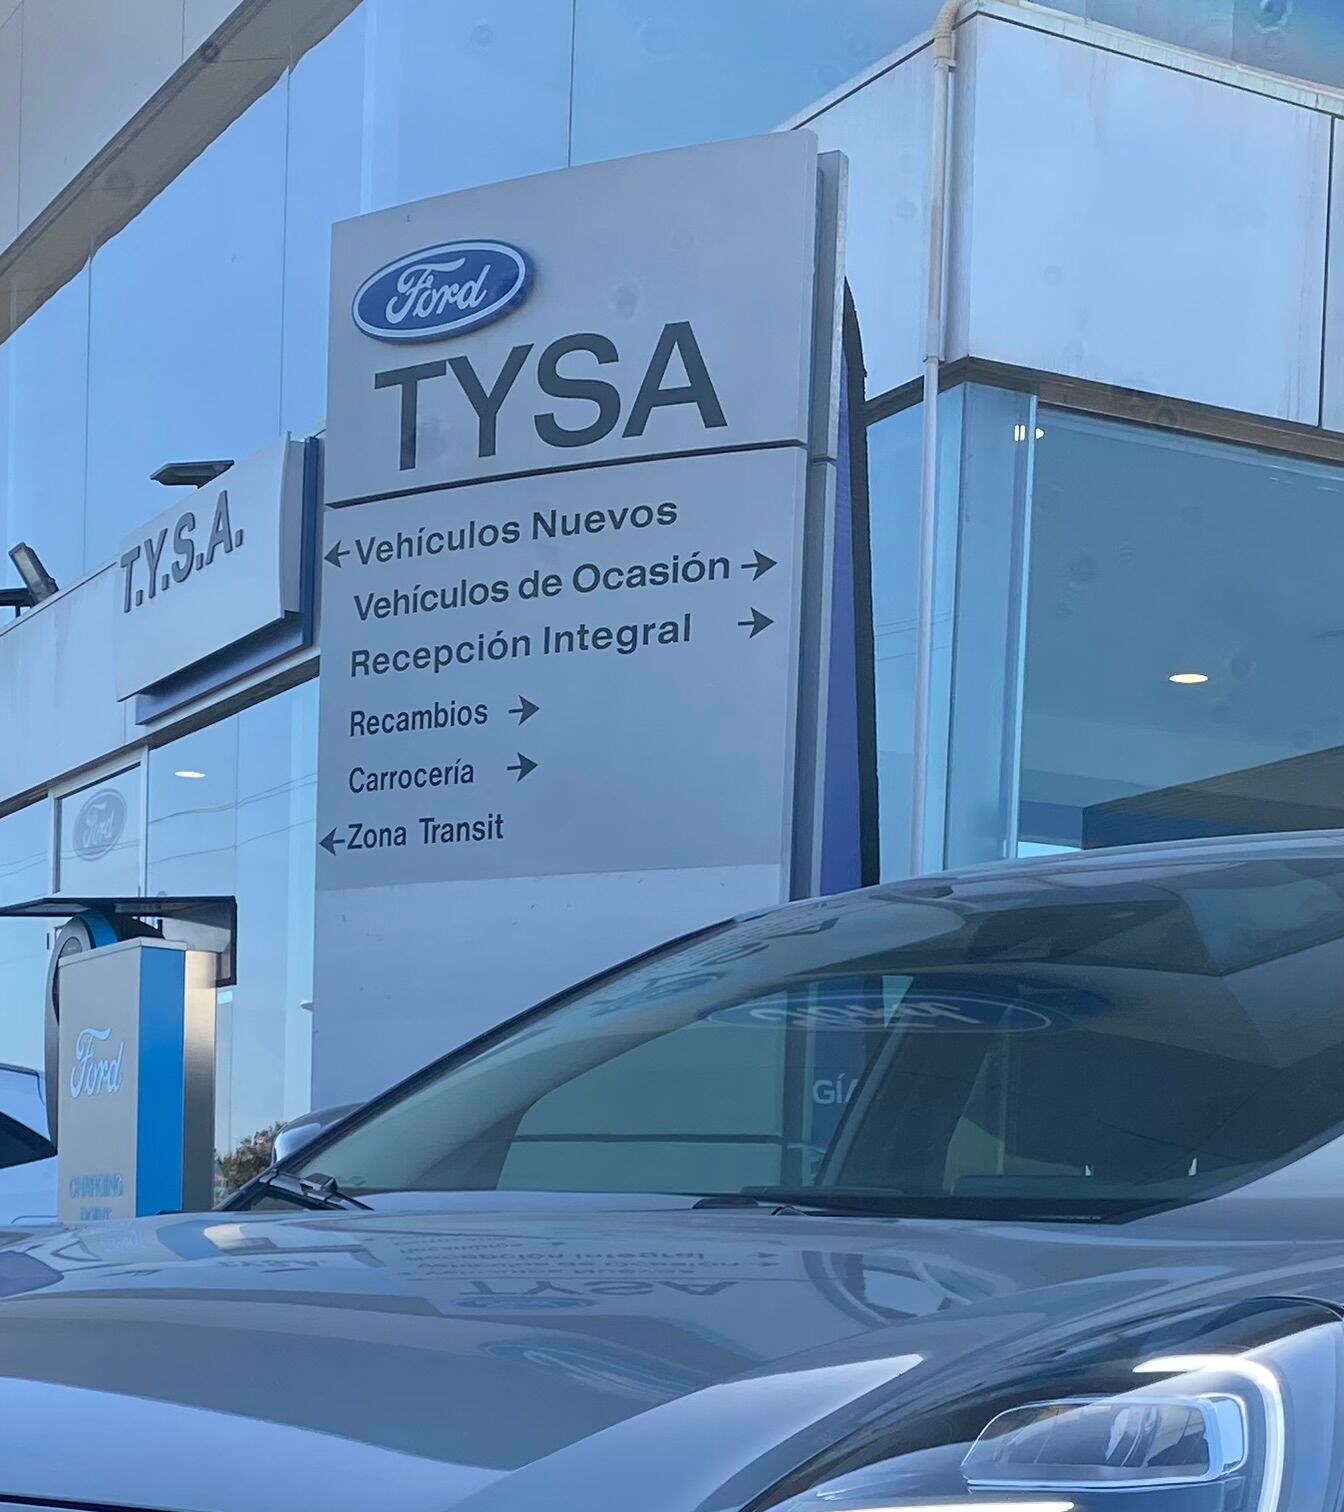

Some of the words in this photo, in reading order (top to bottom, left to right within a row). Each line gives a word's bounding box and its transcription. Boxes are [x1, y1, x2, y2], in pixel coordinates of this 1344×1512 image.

[385, 257, 491, 324] Ford
[374, 321, 728, 471] TYSA
[120, 490, 244, 613] T.Y.S.A.
[355, 520, 520, 565] Vehículos
[531, 502, 678, 540] Nuevos
[354, 579, 509, 621] Vehículos
[518, 571, 562, 600] de
[572, 551, 731, 593] Ocasión
[351, 630, 531, 677] Recepción
[544, 613, 691, 655] Integral
[350, 700, 488, 737] Recambios
[349, 758, 474, 793] Carrocería
[347, 823, 407, 850] Zona
[419, 813, 504, 844] Transit
[71, 1027, 125, 1098] Ford
